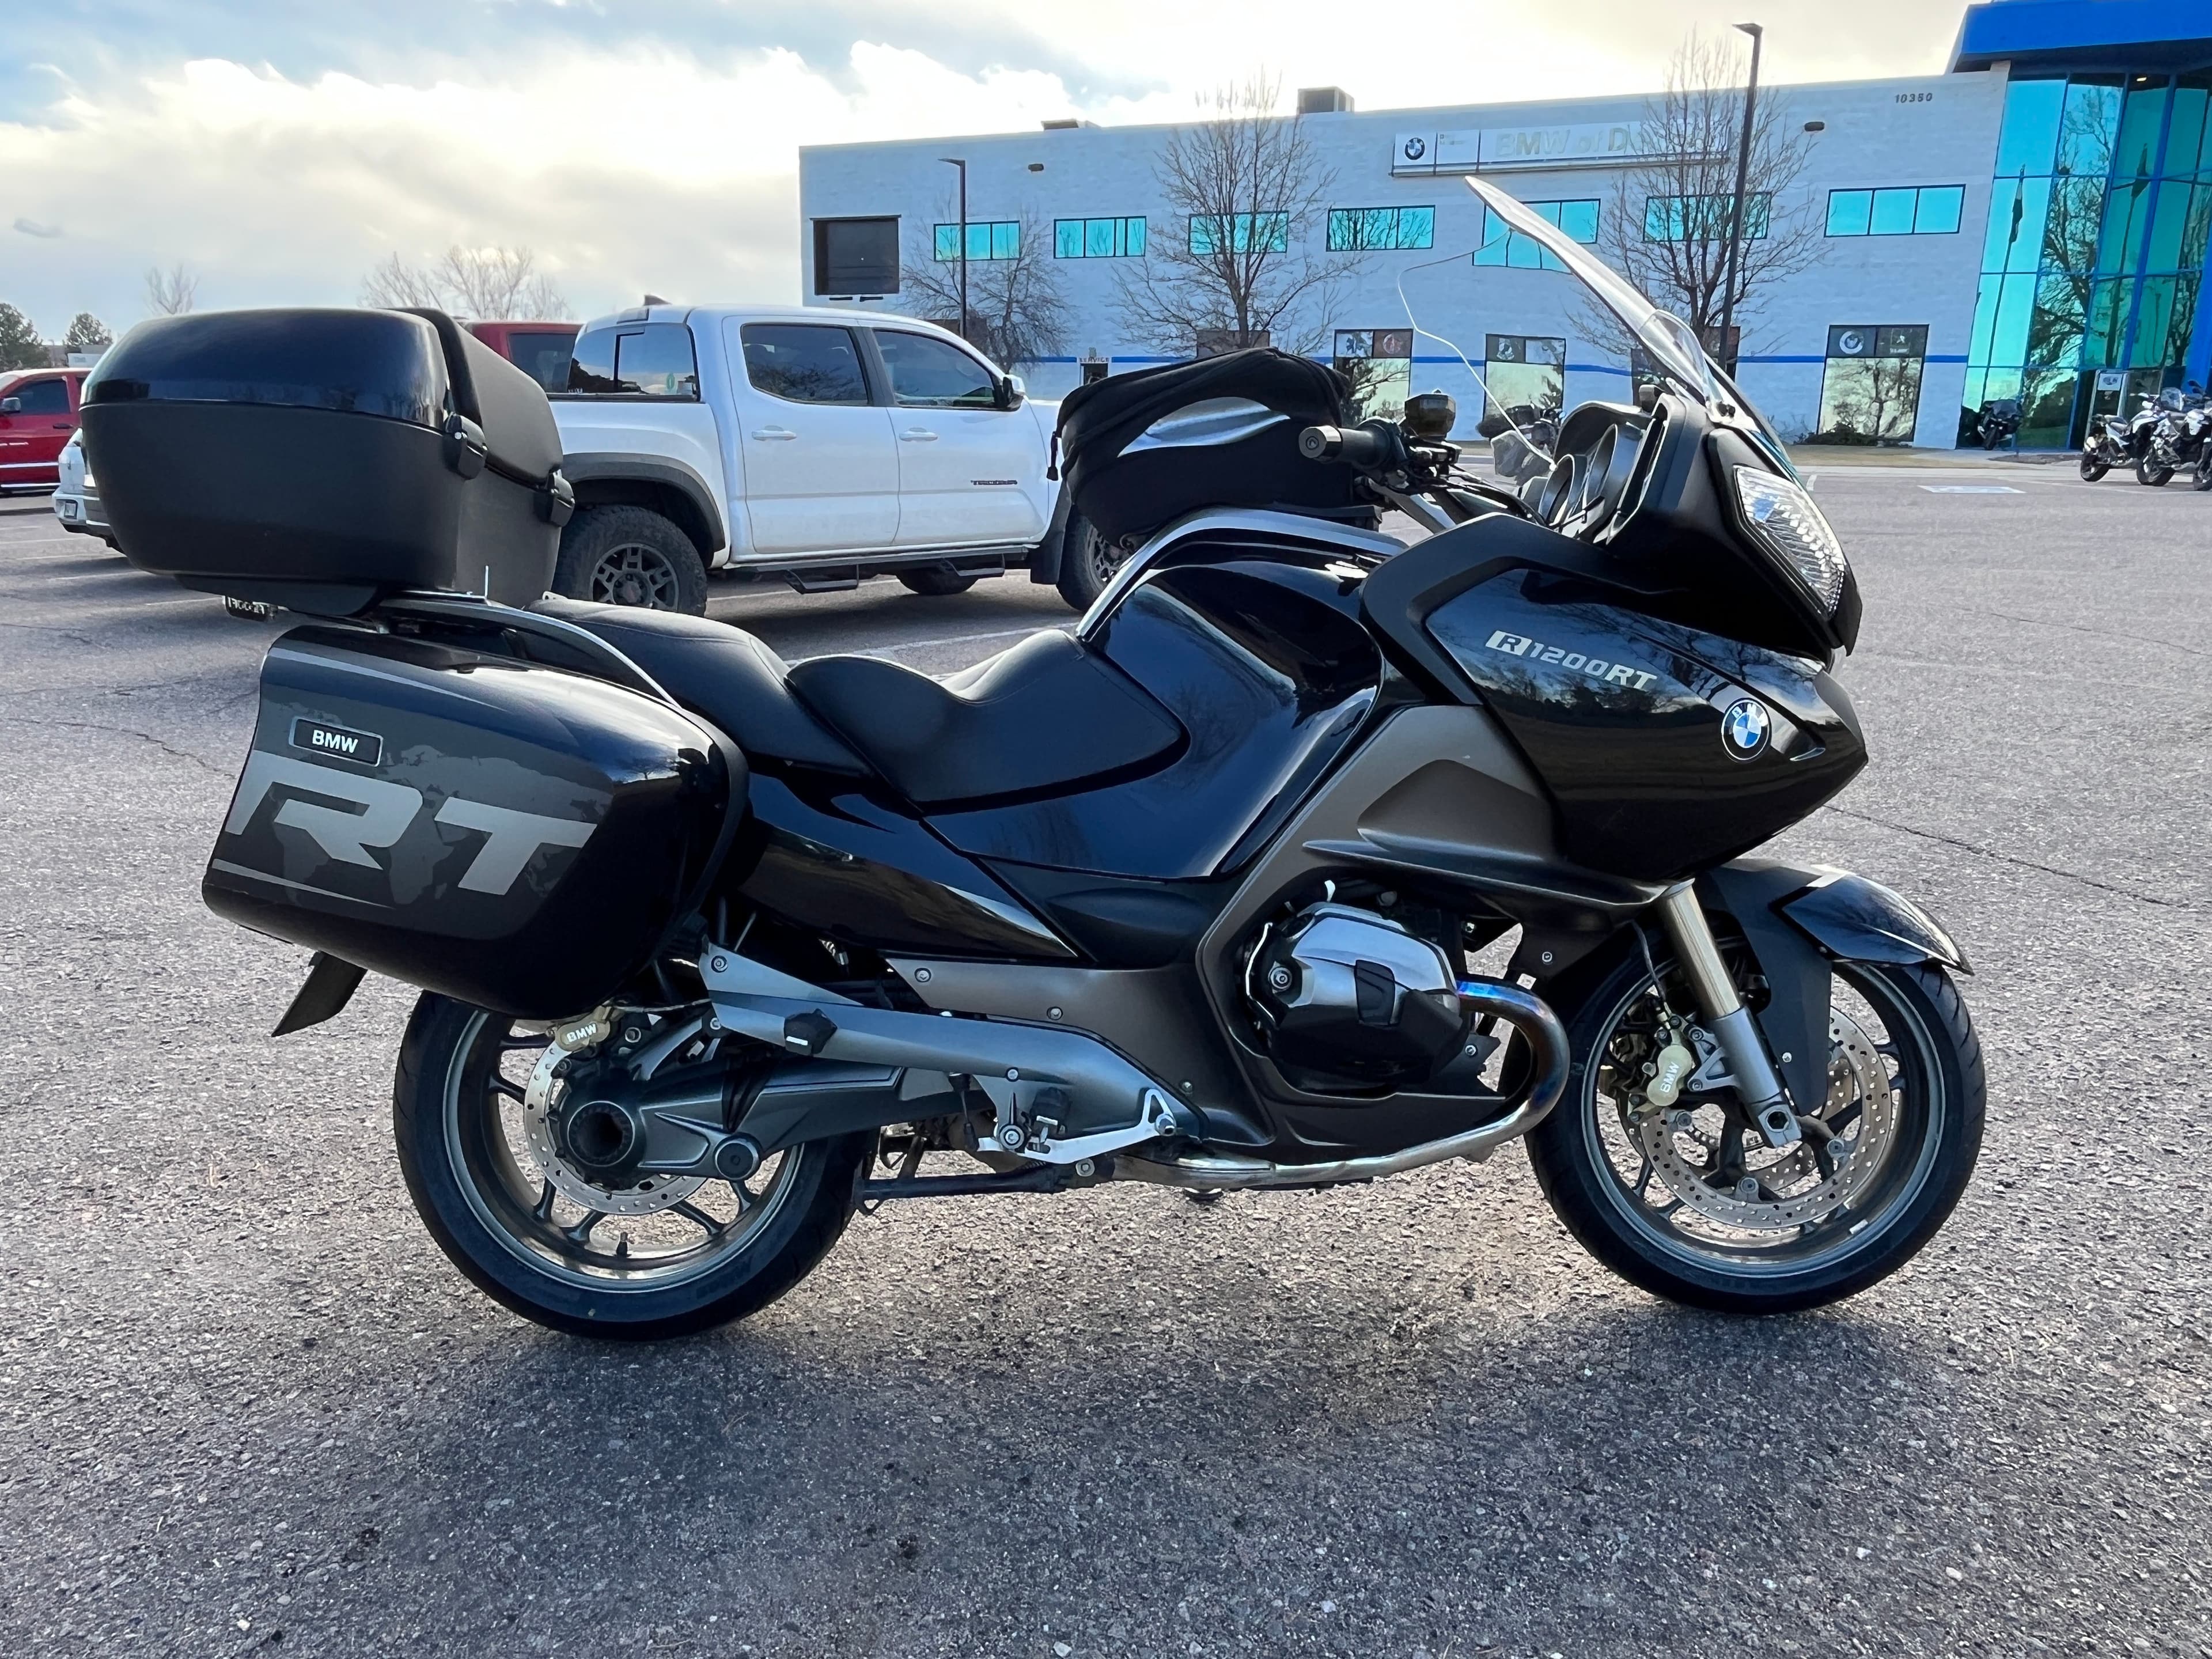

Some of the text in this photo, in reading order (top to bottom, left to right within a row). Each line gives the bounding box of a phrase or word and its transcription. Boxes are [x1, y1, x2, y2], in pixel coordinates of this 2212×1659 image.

[1497, 130, 1571, 156] BMW
[312, 729, 358, 753] BMW
[225, 749, 597, 895] RT
[567, 1024, 596, 1042] BMW
[1660, 1062, 1680, 1093] BMW
